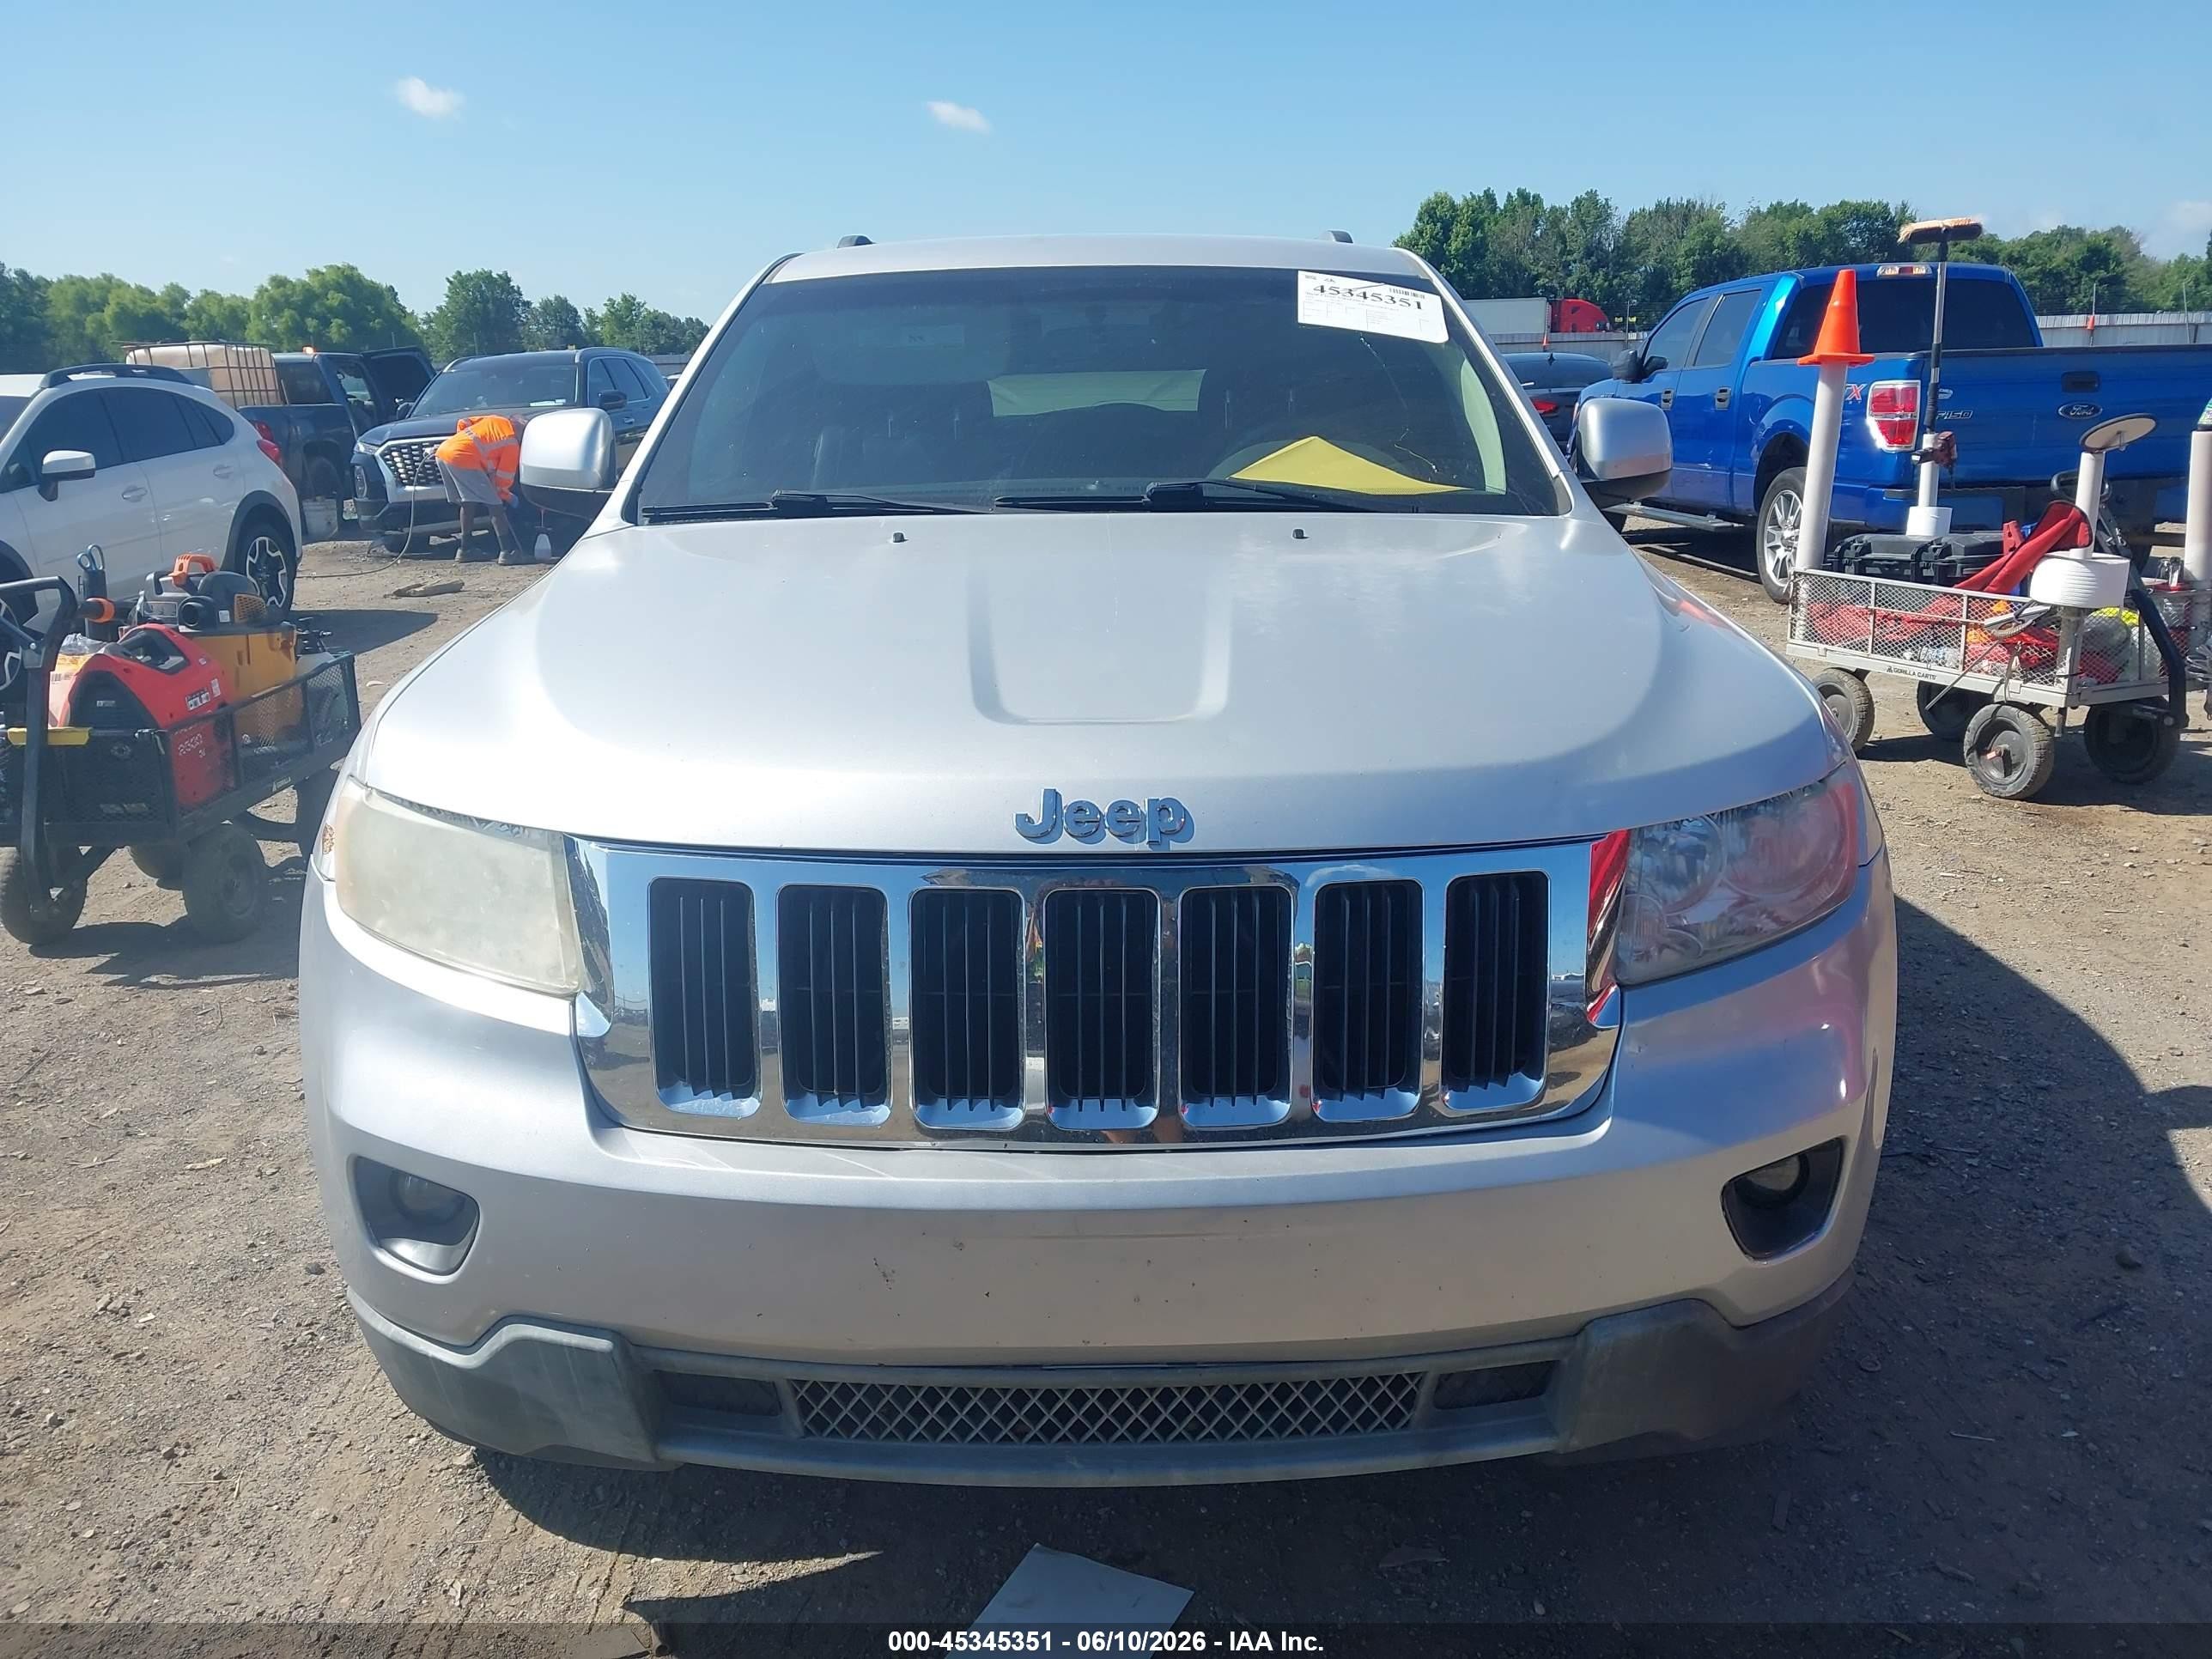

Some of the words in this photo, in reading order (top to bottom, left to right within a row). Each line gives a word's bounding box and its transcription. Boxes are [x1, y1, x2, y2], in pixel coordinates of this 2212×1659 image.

[1313, 285, 1422, 310] 45345351
[2070, 404, 2094, 416] Ford
[1893, 667, 1916, 676] GORILLA
[1015, 787, 1192, 849] Jeep
